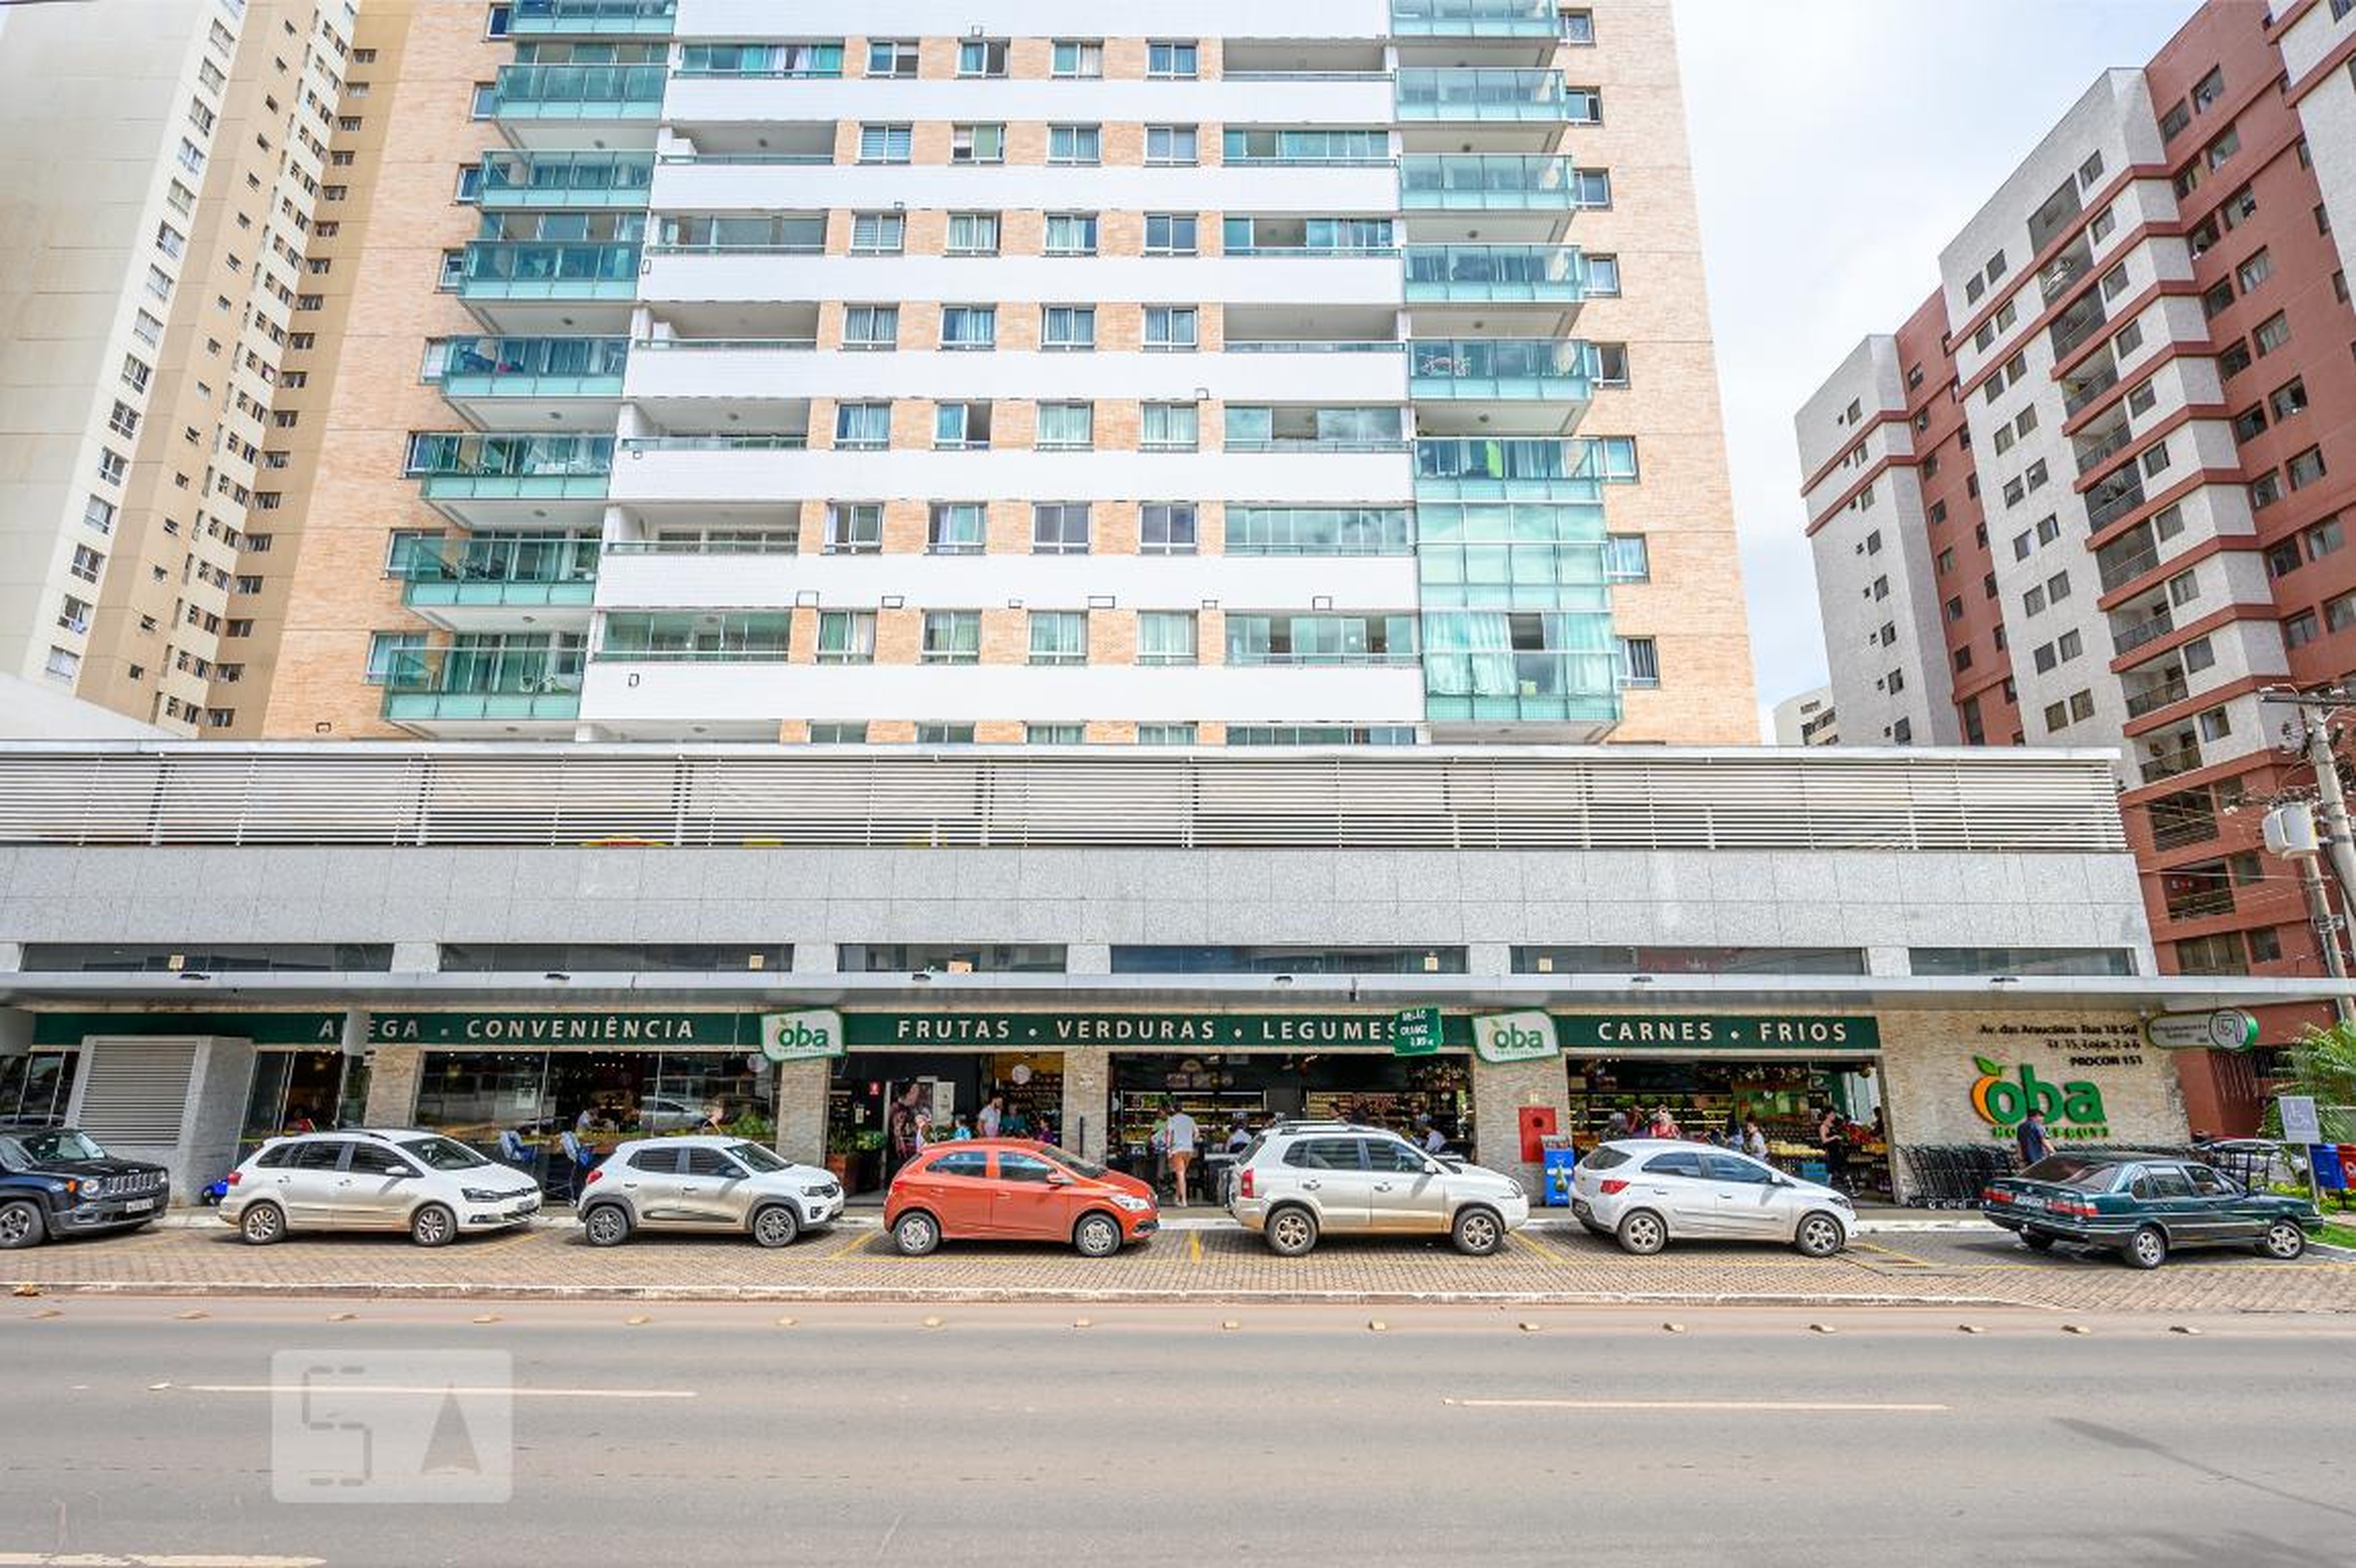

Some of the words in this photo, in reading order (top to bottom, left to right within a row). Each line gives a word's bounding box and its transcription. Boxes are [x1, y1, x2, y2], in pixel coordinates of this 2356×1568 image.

[318, 1020, 419, 1038] AEGA
[466, 1016, 693, 1038] CONVENIÊNCIA
[778, 1020, 830, 1047] oba
[898, 1020, 1009, 1038] FRUTAS
[1057, 1020, 1214, 1039] VERDURAS
[1493, 1022, 1544, 1048] oba
[1598, 1022, 1714, 1040] CARNES
[1759, 1023, 1847, 1041] FRIOS
[1985, 1064, 2107, 1125] oba
